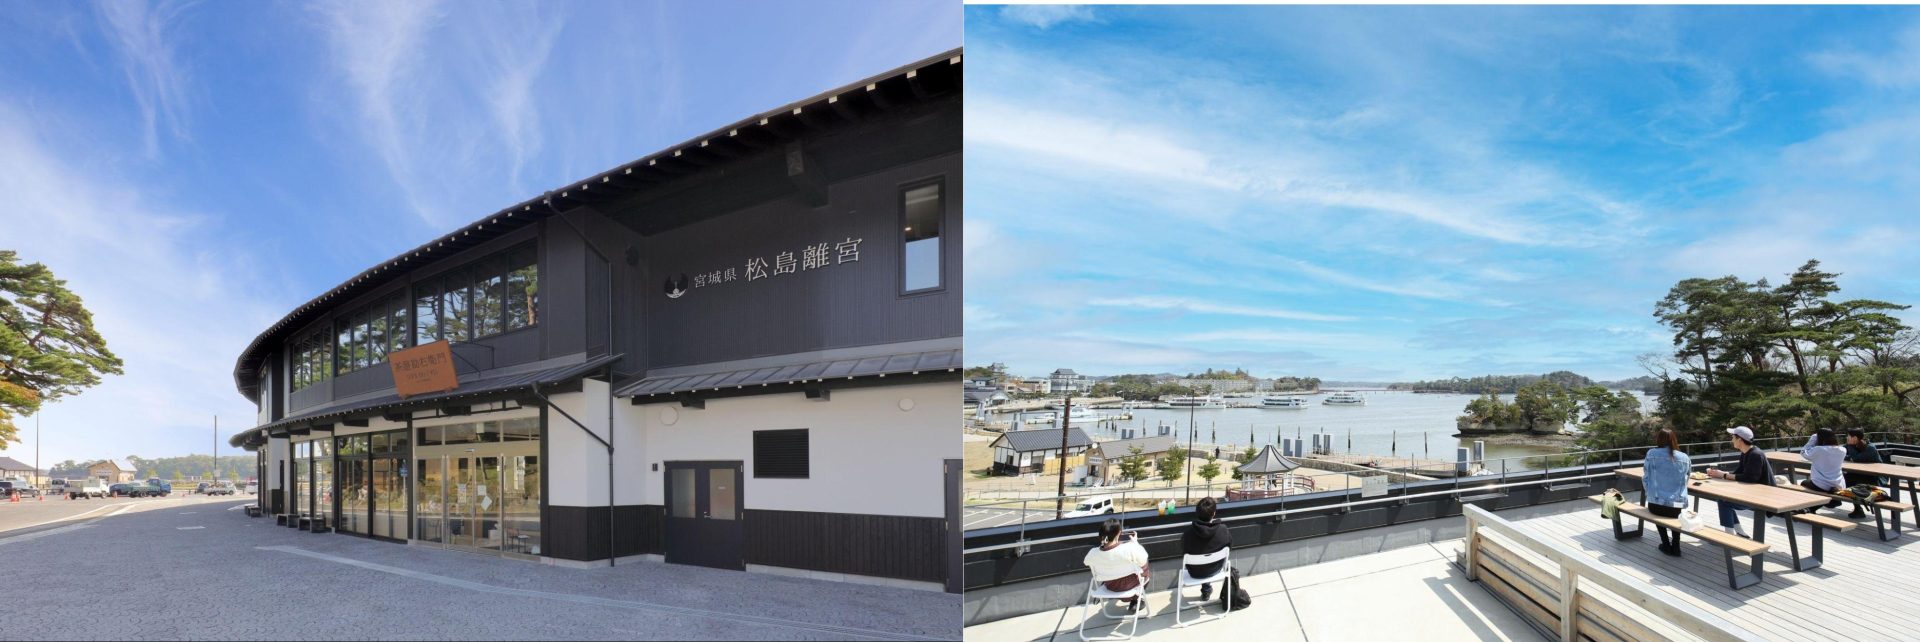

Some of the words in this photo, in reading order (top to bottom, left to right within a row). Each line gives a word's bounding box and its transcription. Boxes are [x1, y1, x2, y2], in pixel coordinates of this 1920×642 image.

[694, 267, 737, 289] 宮城県
[744, 237, 863, 282] 松島離宮
